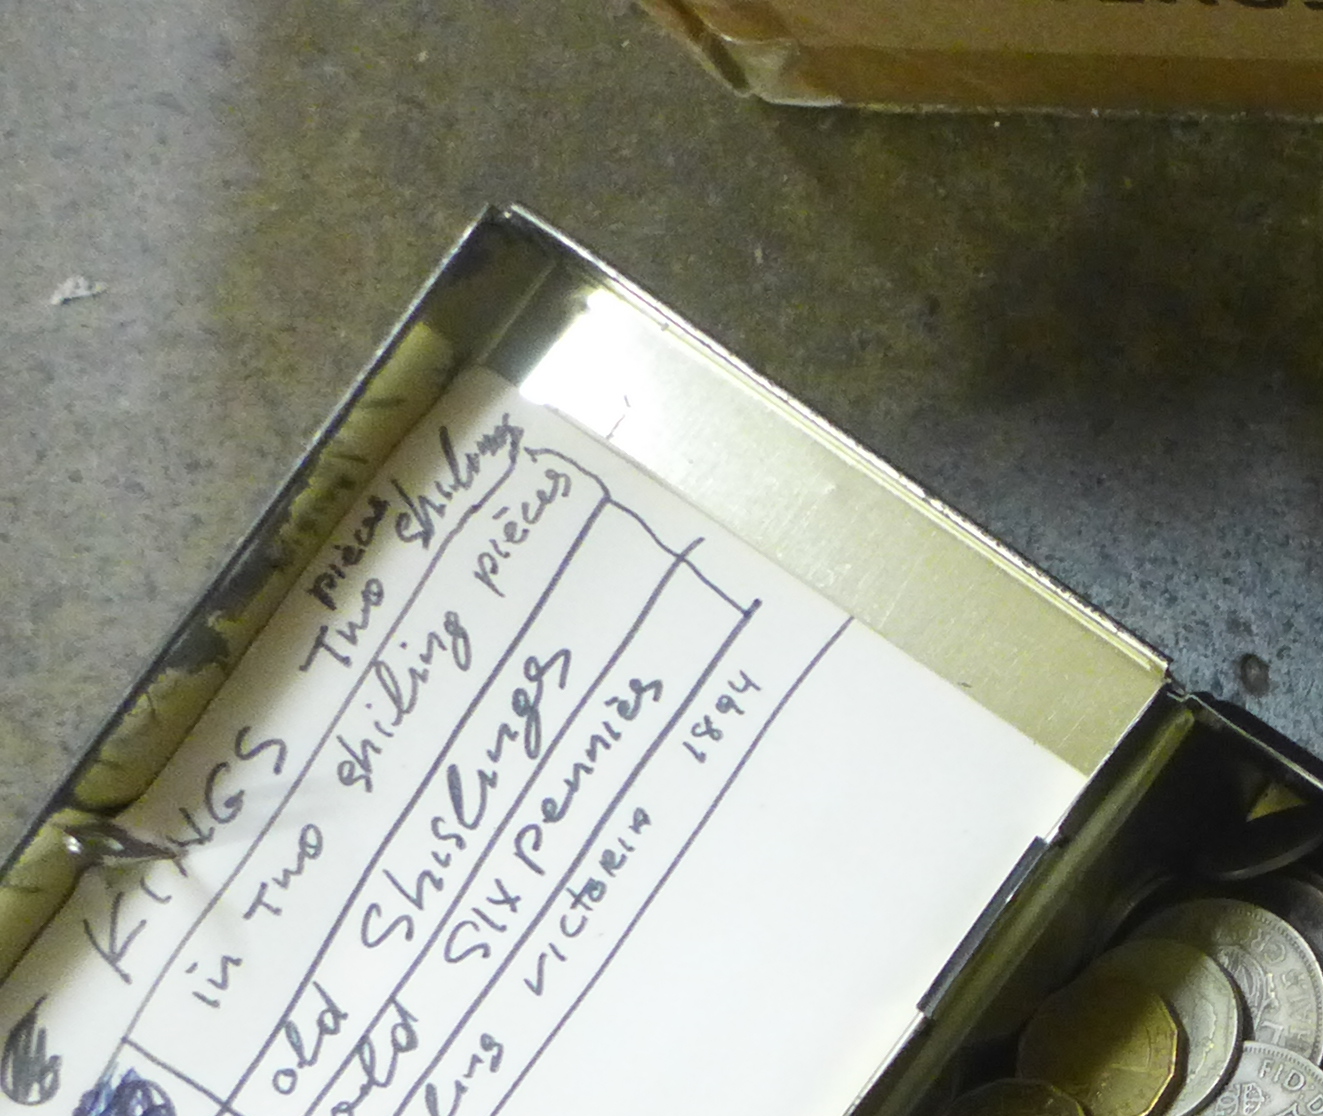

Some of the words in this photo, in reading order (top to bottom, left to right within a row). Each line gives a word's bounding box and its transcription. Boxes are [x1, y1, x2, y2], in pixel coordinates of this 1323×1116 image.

[299, 577, 385, 672] Two
[682, 670, 762, 763] 1894
[185, 955, 243, 1009] in
[243, 823, 323, 920] Two
[272, 980, 348, 1095] old
